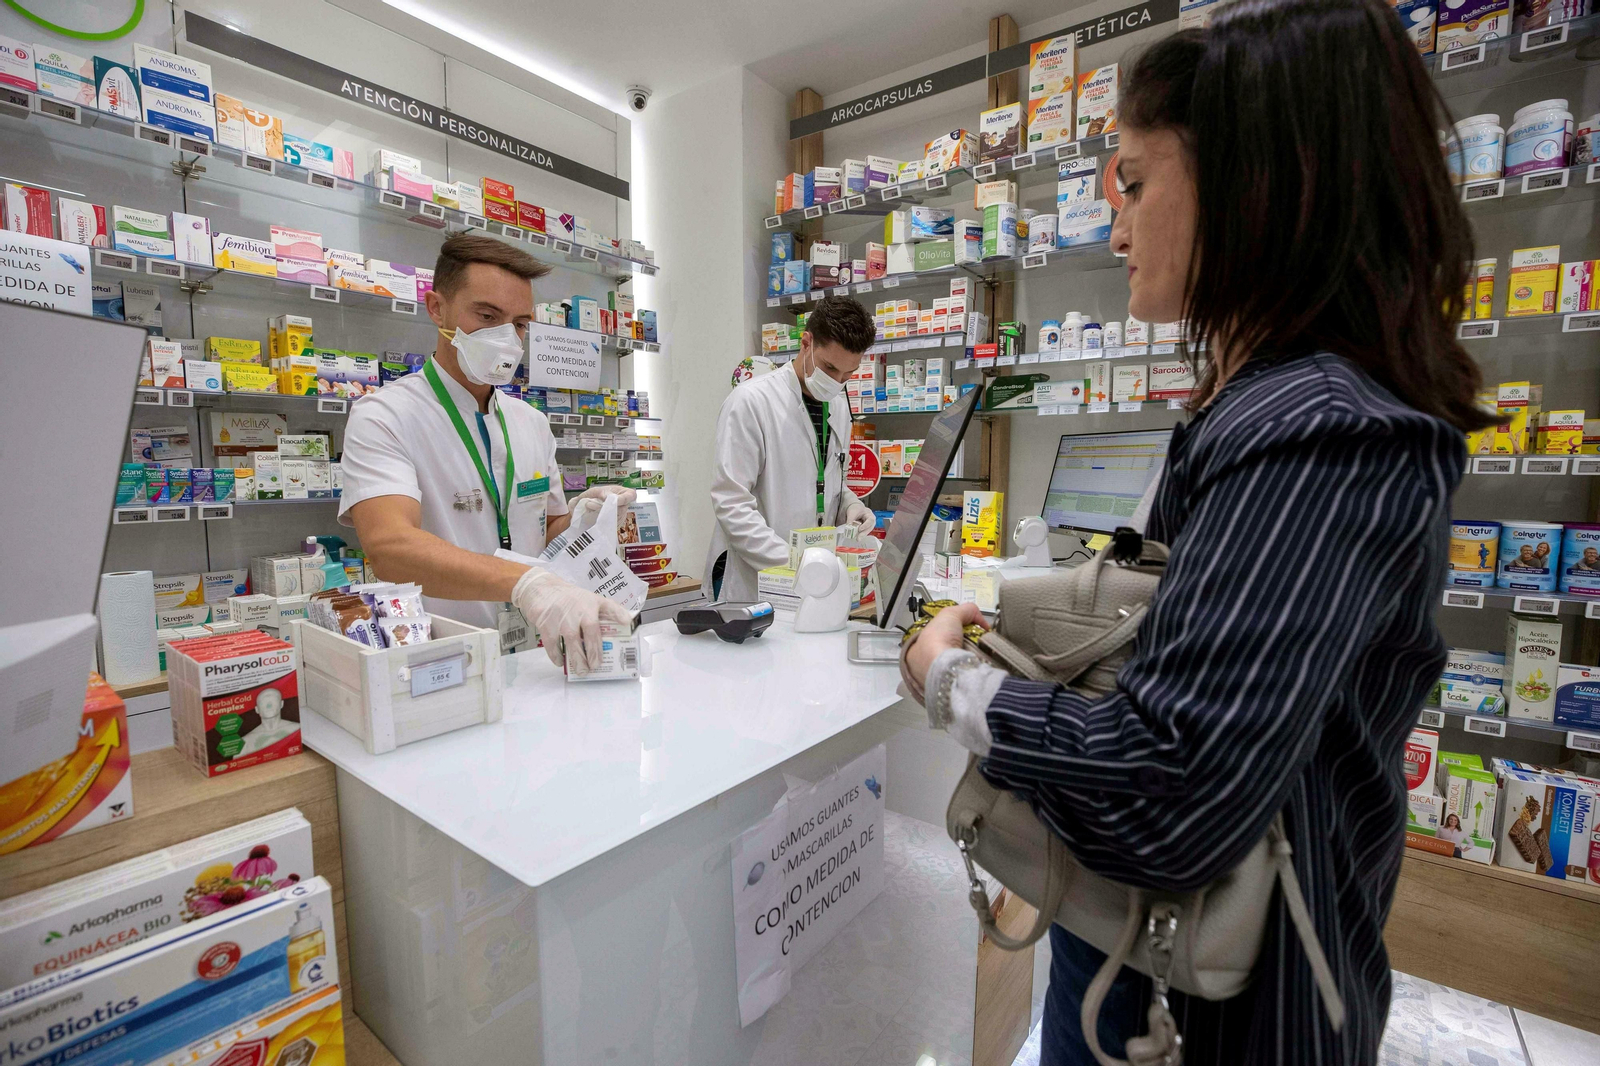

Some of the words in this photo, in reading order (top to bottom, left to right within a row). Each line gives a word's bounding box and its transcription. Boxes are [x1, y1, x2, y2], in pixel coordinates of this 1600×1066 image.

[1461, 3, 1497, 21] PediaSure
[1036, 47, 1068, 60] Meritene
[149, 57, 197, 76] ANDROMAS
[1039, 60, 1063, 68] VITALIDAD
[1082, 76, 1114, 90] Meritene
[1085, 89, 1110, 99] VITALIDAD
[1086, 86, 1103, 94] FUERZA
[831, 79, 933, 123] ARKOCAPSULAS
[156, 99, 202, 118] ANDROMAS
[1036, 103, 1064, 114] Meritene
[341, 79, 433, 124] ATENCIÓN
[439, 114, 555, 169] PERSONALIZADA
[986, 112, 1013, 125] Meritene
[1514, 123, 1549, 138] EPAPLUS
[1061, 157, 1095, 171] PROGEN
[124, 214, 153, 224] NATALBEN
[1066, 207, 1102, 219] DOLOCARE
[126, 239, 154, 247] NATALBEN
[218, 236, 272, 256] femibion
[327, 250, 359, 264] femibion
[918, 248, 952, 260] OlioVita
[231, 260, 236, 269] 1
[338, 267, 369, 282] femibion
[54, 283, 76, 298] DE
[126, 286, 154, 296] Lubristil
[544, 335, 566, 344] USAMOS
[567, 338, 589, 347] GUANTES
[553, 345, 585, 355] MASCARILLAS
[537, 353, 560, 363] COMO
[561, 356, 587, 367] MEDIDA
[588, 360, 596, 368] DE
[546, 367, 589, 379] CONTENCION
[1152, 366, 1192, 376] Sarcodyn
[280, 437, 310, 446] Finocarbo
[966, 498, 980, 525] Lizis
[1453, 526, 1492, 536] Colnatur
[1513, 530, 1547, 539] Colnatur
[205, 574, 234, 582] Strepsils
[154, 581, 185, 590] Strepsils
[163, 613, 194, 623] Strepsils
[1520, 645, 1556, 656] ORDESA
[205, 654, 291, 677] PharysolCOLD
[432, 673, 445, 682] 1,65
[1575, 685, 1600, 693] TURB
[207, 698, 233, 711] Herbal
[234, 695, 252, 705] Cold
[1447, 692, 1462, 701] tcd
[207, 703, 246, 717] Complex
[1449, 784, 1459, 812] MEDICAL
[1558, 792, 1574, 835] KOMPLETT
[1574, 794, 1592, 834] biManán
[771, 818, 815, 862] USAMOS
[817, 785, 860, 827] GUANTES
[786, 813, 854, 874] MASCARILLAS
[1417, 838, 1447, 850] EFECTIVA
[806, 839, 858, 890] MEDIDA
[860, 823, 875, 850] DE
[69, 893, 163, 937] Arkopharma
[33, 927, 139, 977] EQUINÁCEA
[143, 914, 172, 934] BIO
